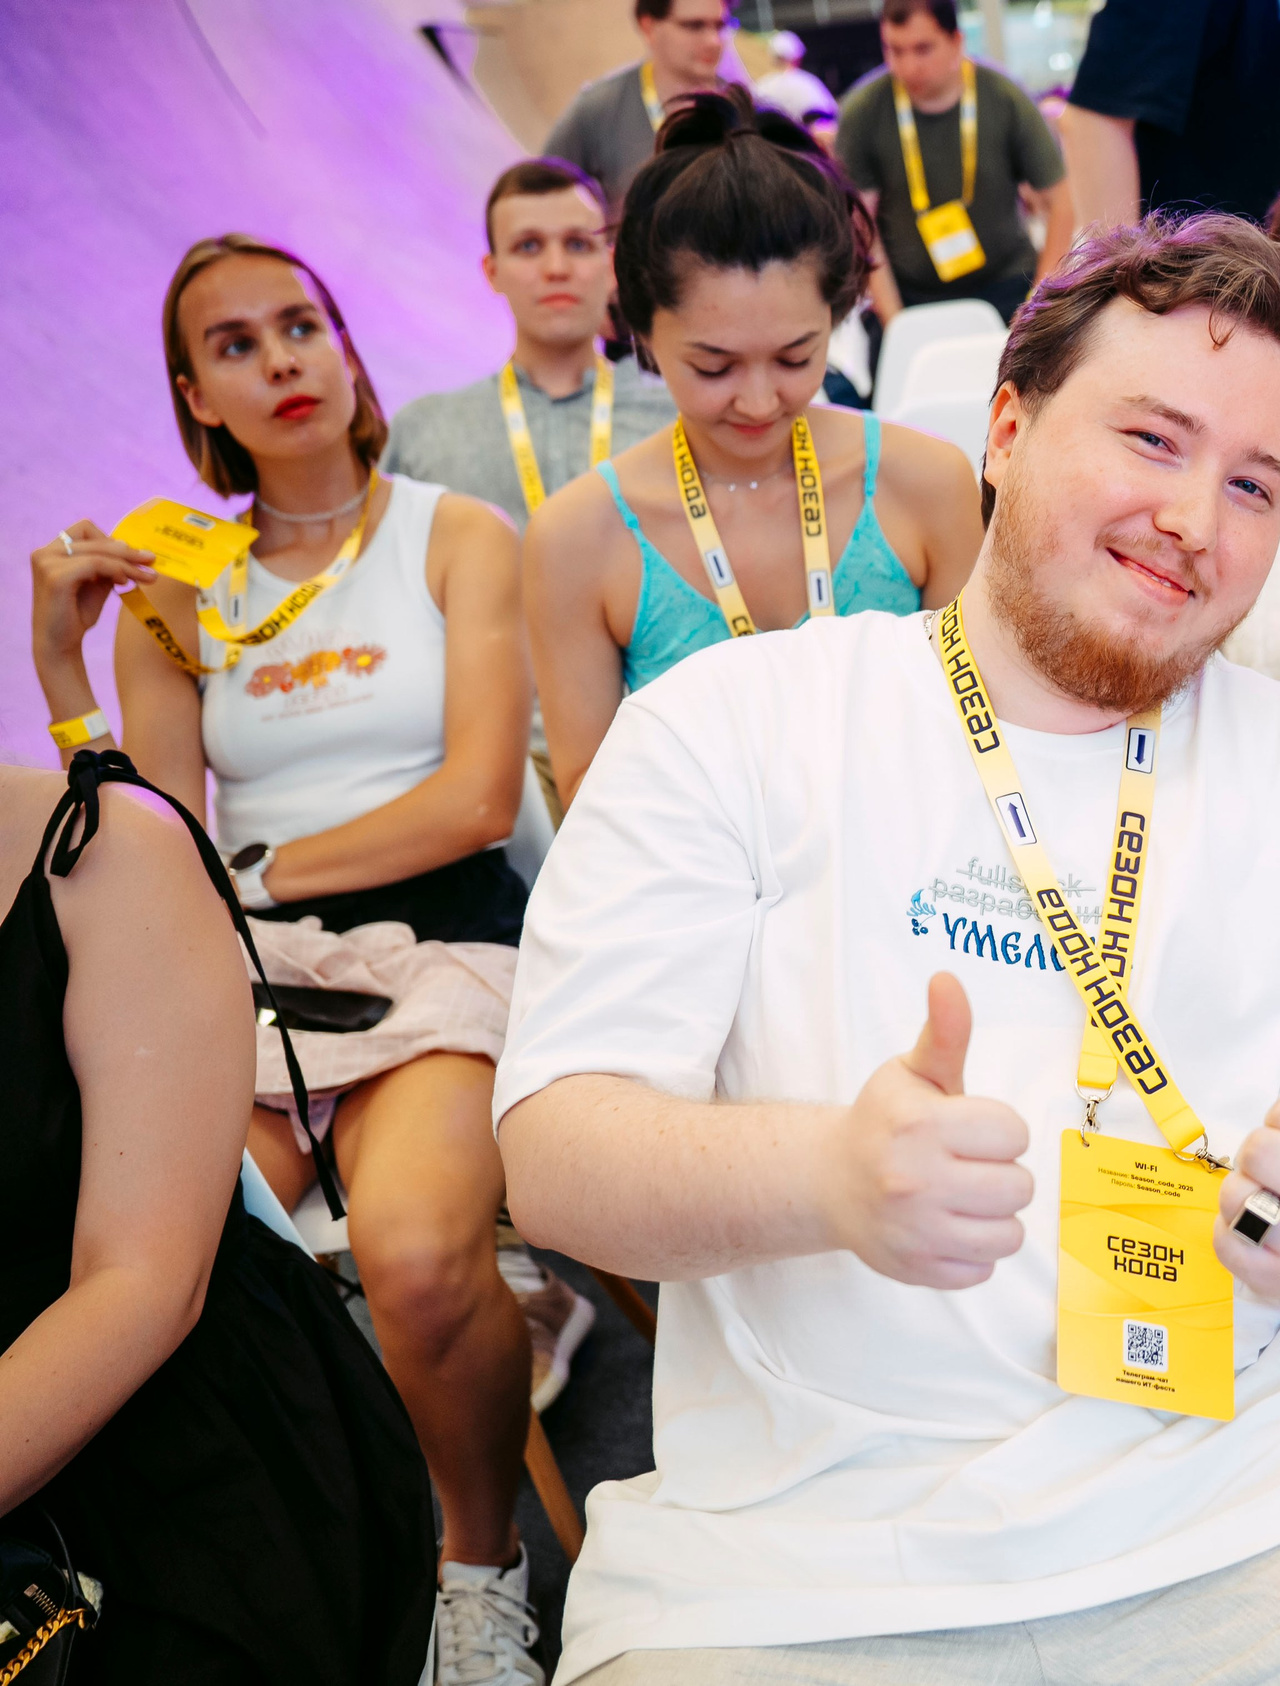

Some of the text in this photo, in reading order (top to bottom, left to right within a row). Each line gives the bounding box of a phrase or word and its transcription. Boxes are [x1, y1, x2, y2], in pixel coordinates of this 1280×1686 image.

[797, 457, 822, 537] сезон
[947, 649, 1000, 754] сезон
[1098, 811, 1146, 998] сезон ко
[1037, 888, 1168, 1095] сезон кода
[1098, 1167, 1194, 1192] Название: Season_code_2025
[1134, 1161, 1159, 1173] WI-FI
[1111, 1178, 1181, 1198] Пароль: Season_code
[1107, 1235, 1184, 1265] сезон
[1114, 1255, 1177, 1282] кода
[1122, 1369, 1169, 1384] Телеграм-чат
